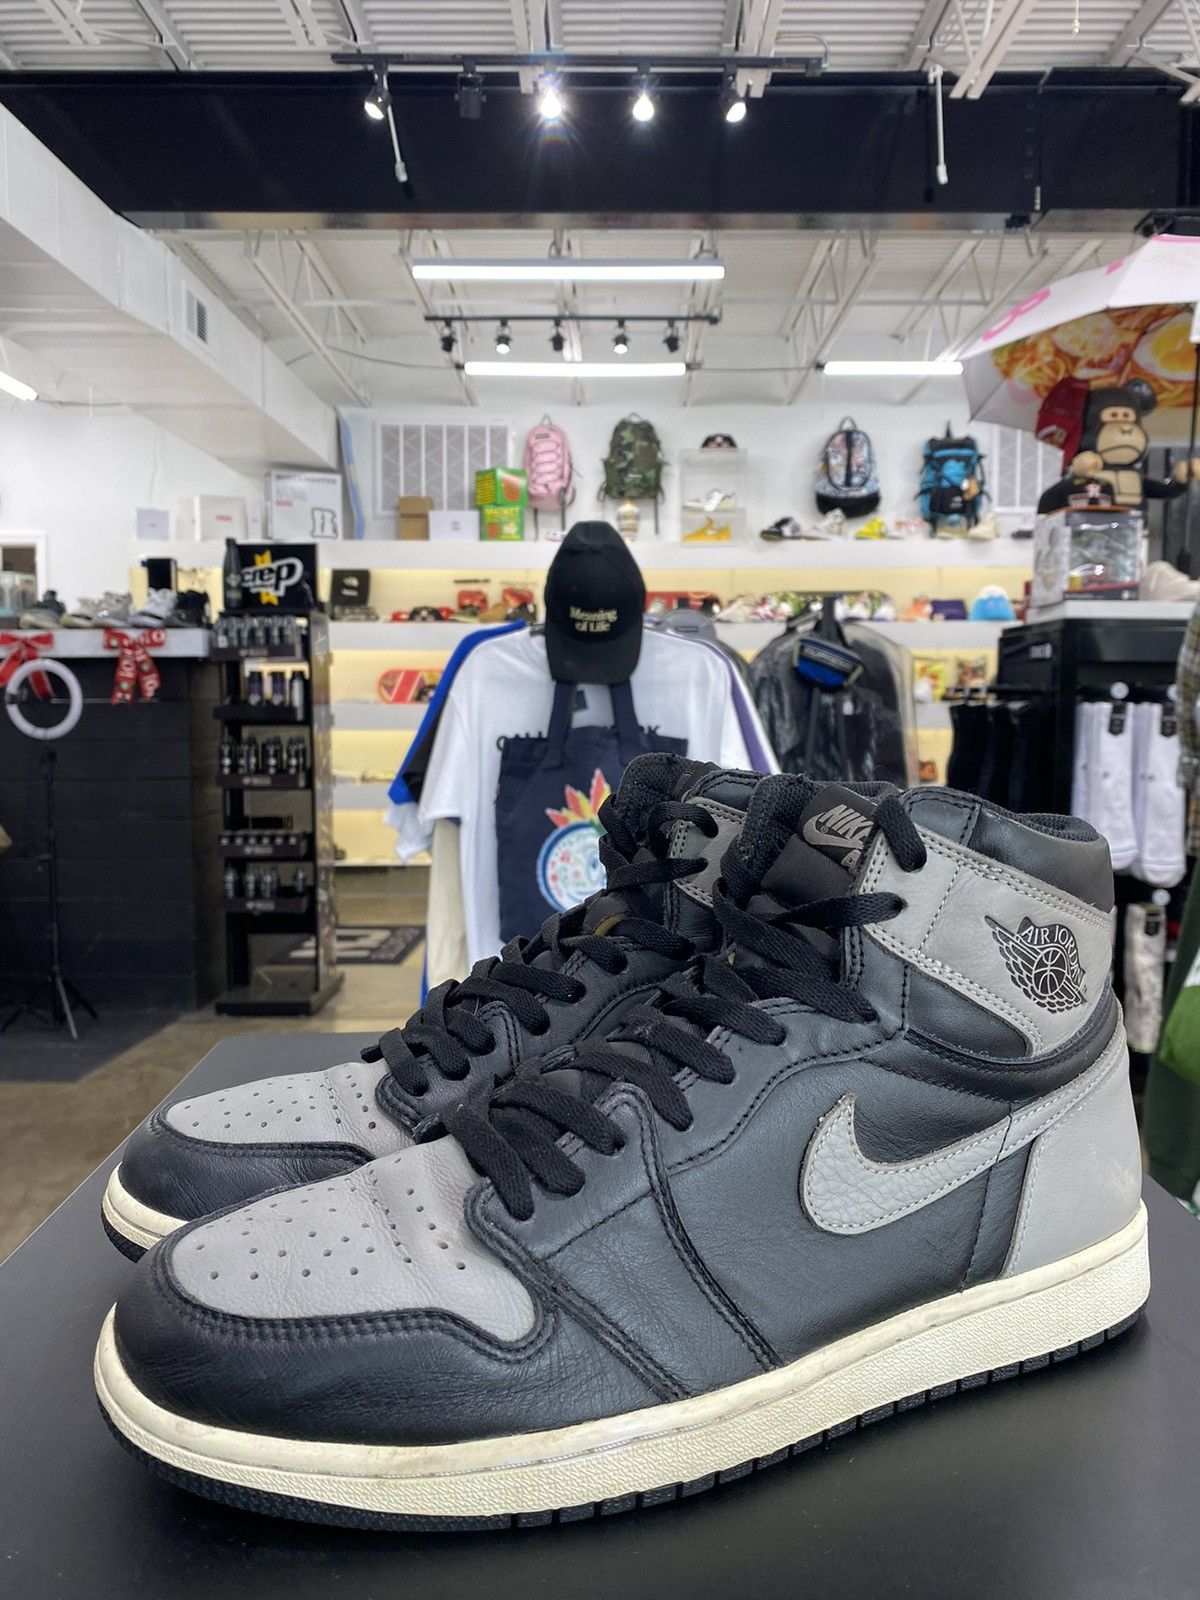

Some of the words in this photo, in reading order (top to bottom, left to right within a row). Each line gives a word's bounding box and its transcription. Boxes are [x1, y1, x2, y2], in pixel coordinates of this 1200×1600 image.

[575, 621, 588, 632] of
[589, 620, 611, 632] Life
[1020, 925, 1051, 945] AIR
[1053, 925, 1082, 986] JORDAN
